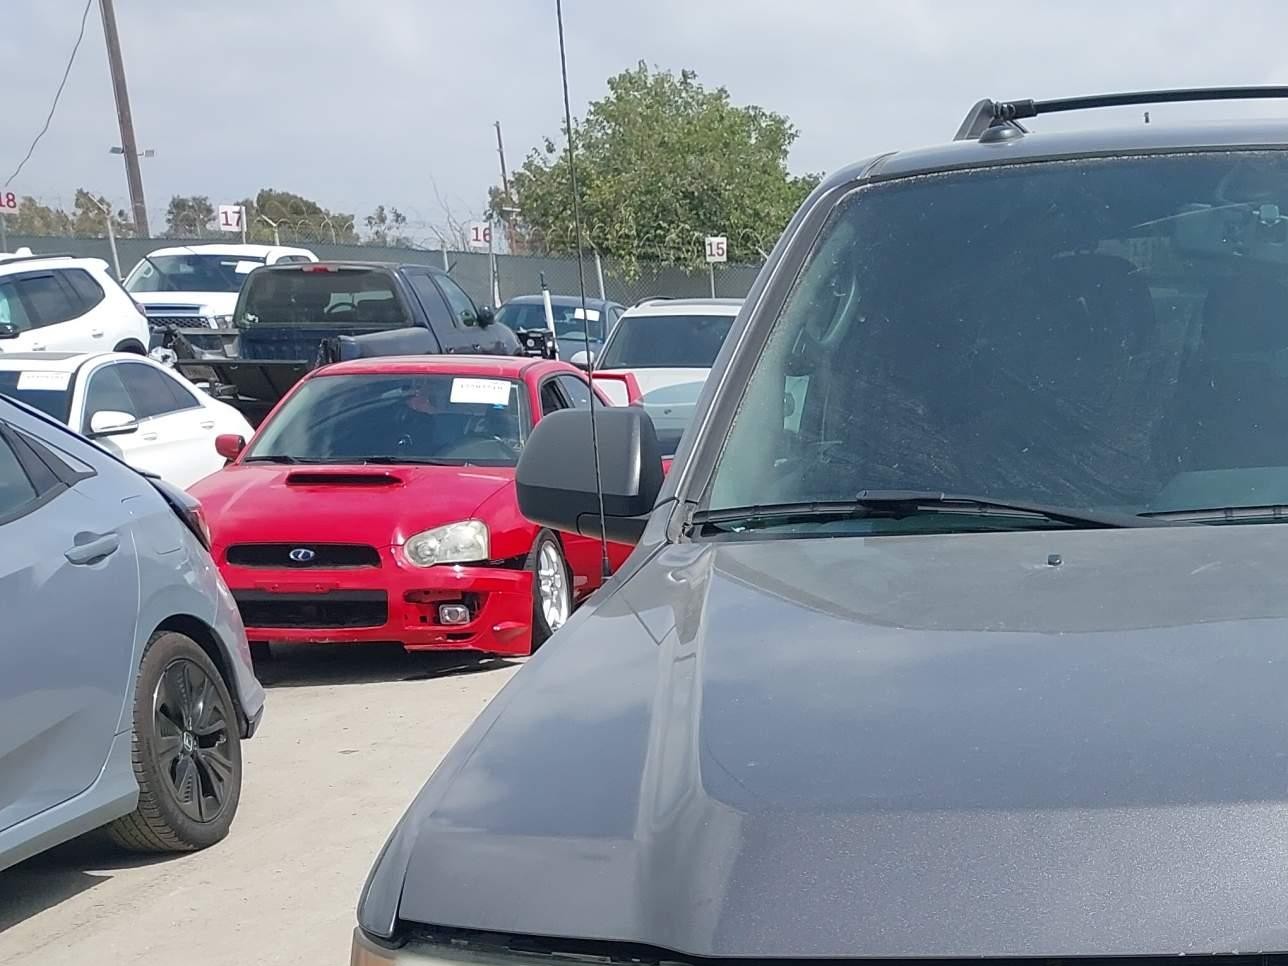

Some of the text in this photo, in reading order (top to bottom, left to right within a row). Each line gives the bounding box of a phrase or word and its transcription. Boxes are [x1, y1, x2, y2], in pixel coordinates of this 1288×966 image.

[221, 210, 241, 227] 17
[471, 226, 491, 243] 16
[707, 241, 726, 257] 15
